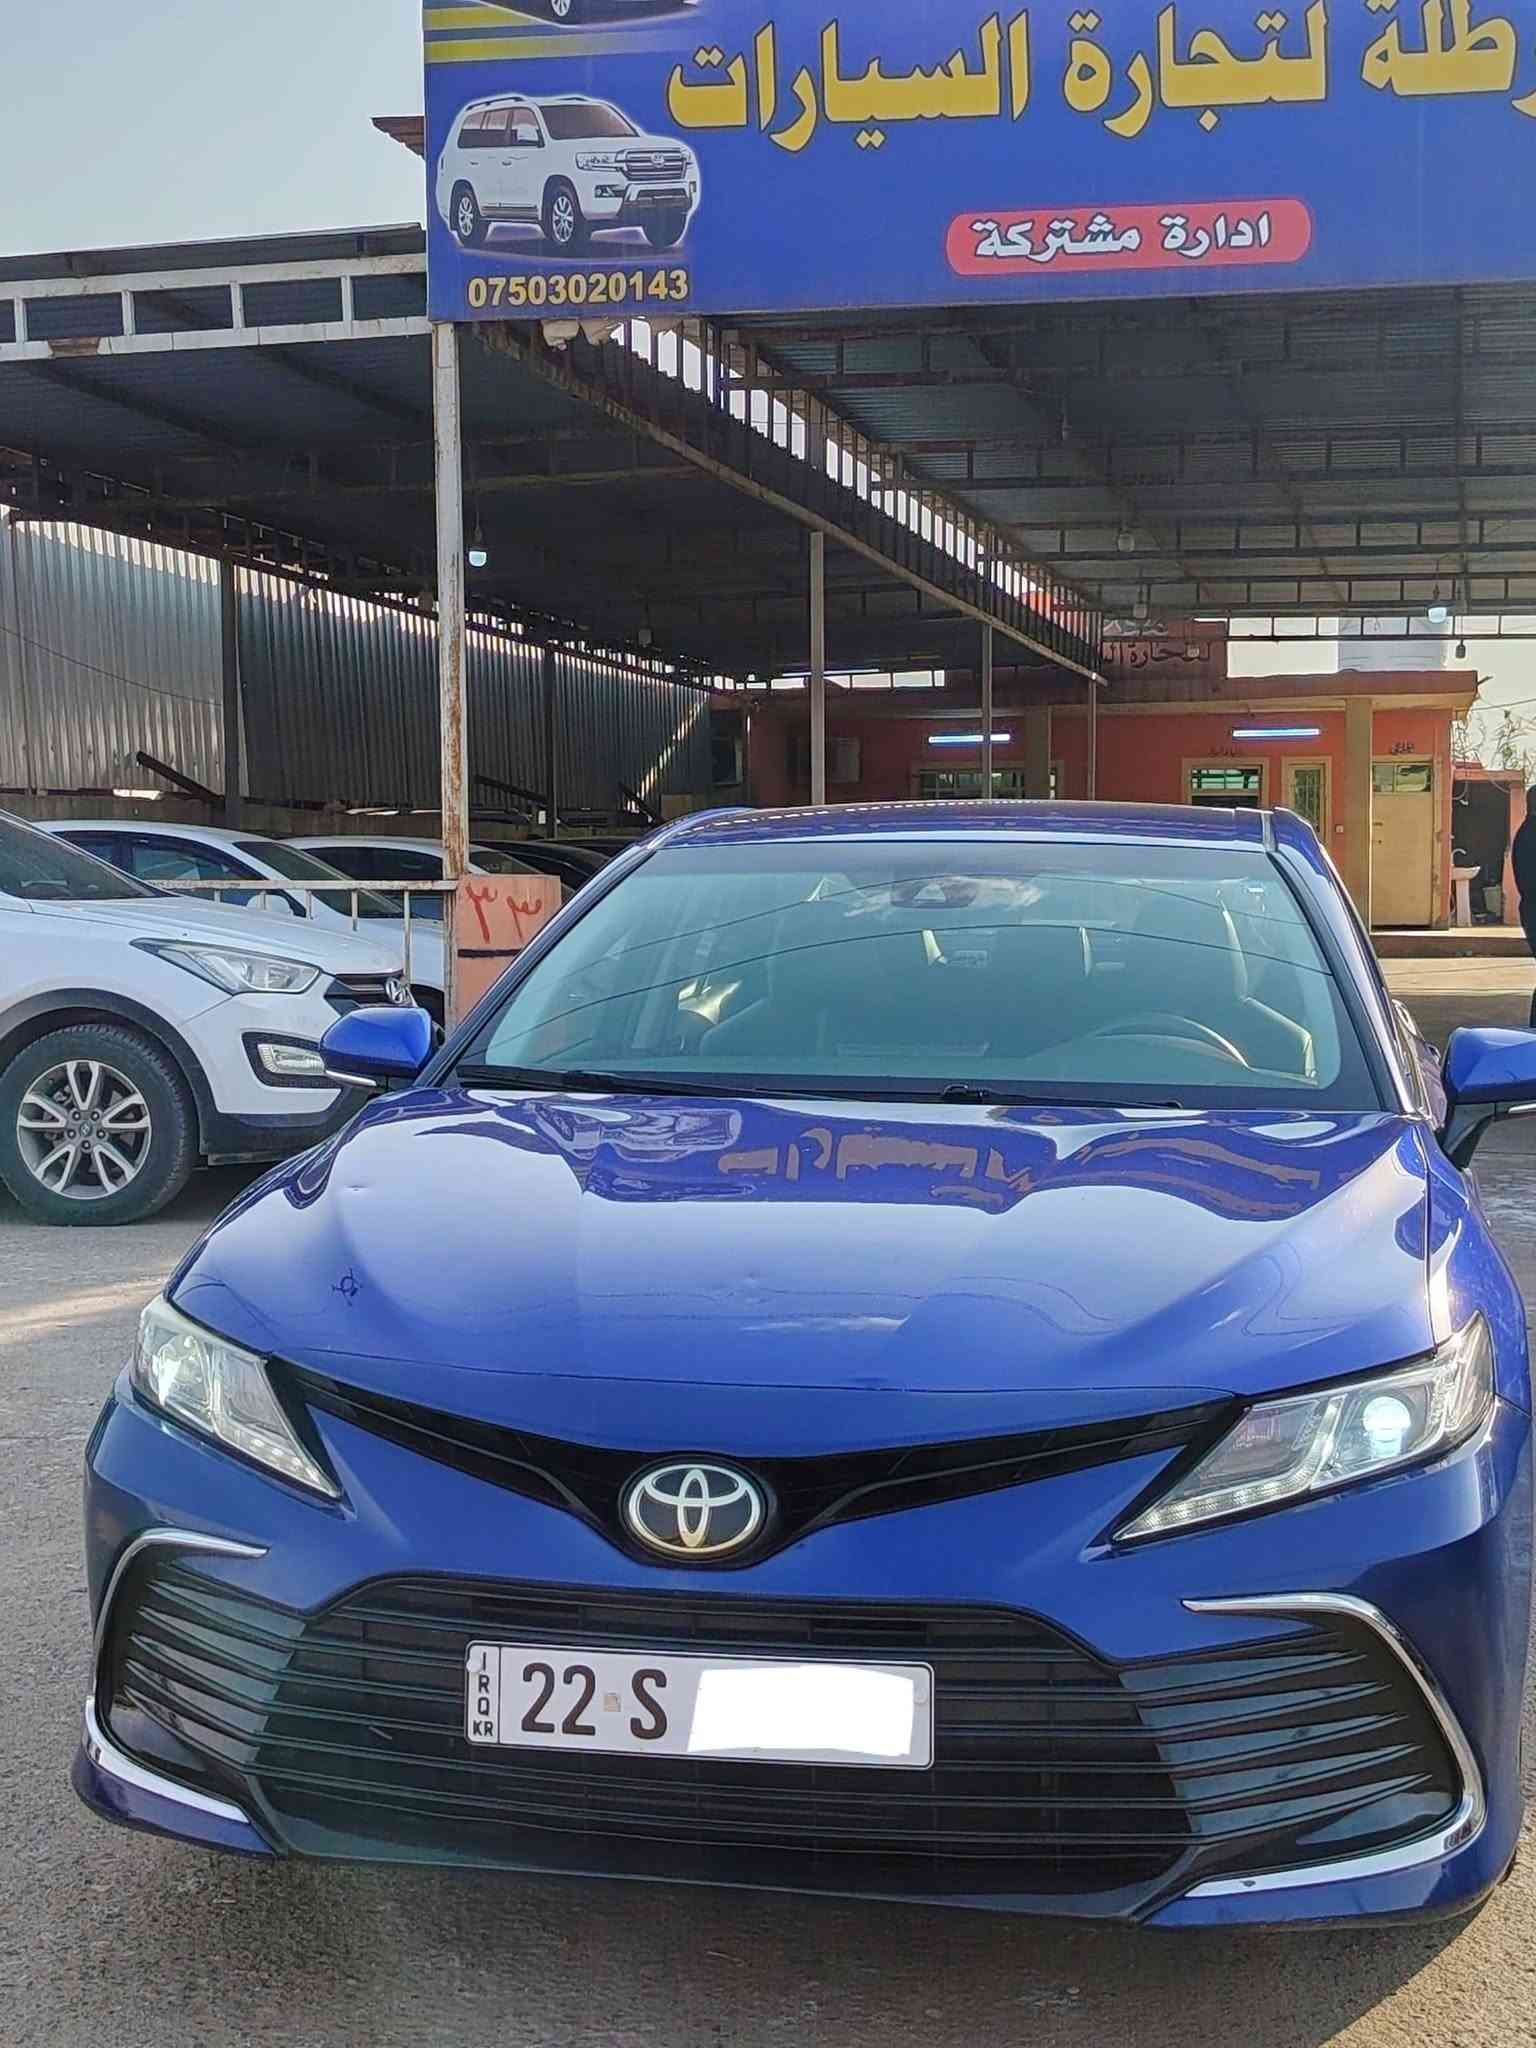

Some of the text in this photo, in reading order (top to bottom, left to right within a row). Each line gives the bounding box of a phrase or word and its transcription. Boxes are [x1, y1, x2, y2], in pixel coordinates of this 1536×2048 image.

[667, 8, 1030, 152] السيارات
[1064, 0, 1328, 138] لتجارة
[971, 211, 1271, 263] ادارة مشتركة
[468, 268, 689, 308] 07503020143
[521, 1662, 667, 1740] 22 S
